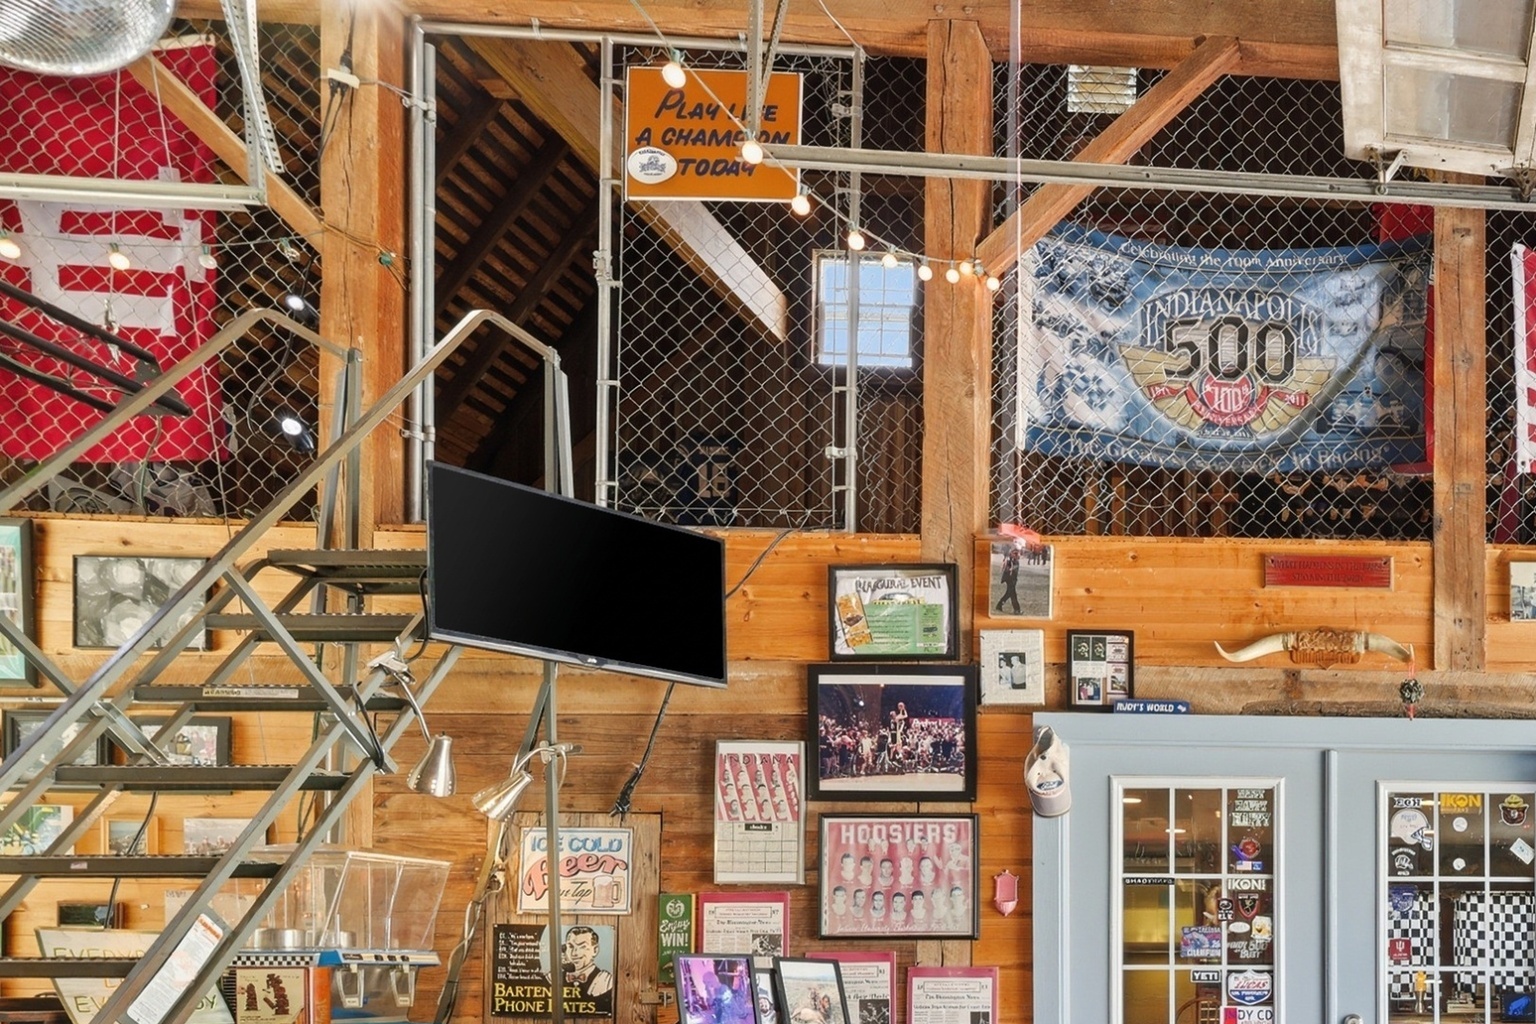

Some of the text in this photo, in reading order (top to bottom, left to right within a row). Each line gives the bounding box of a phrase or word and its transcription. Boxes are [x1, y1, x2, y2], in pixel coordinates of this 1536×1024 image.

[654, 88, 779, 122] PLAY LIE
[635, 127, 791, 147] A CHAMPON
[678, 158, 758, 177] TODAY
[1200, 253, 1221, 266] the
[1162, 315, 1298, 384] 500
[911, 577, 942, 589] EVENT
[1147, 702, 1175, 713] WORLD
[723, 754, 794, 765] INDIANA
[1440, 793, 1483, 807] IKON
[840, 823, 957, 845] HOOSIERS
[568, 835, 623, 852] COLD
[661, 933, 689, 947] WIN!
[1193, 972, 1218, 980] YETI
[494, 982, 581, 999] BARTENER
[1234, 981, 1268, 989] LUCAS
[494, 997, 596, 1014] PHONE ATES
